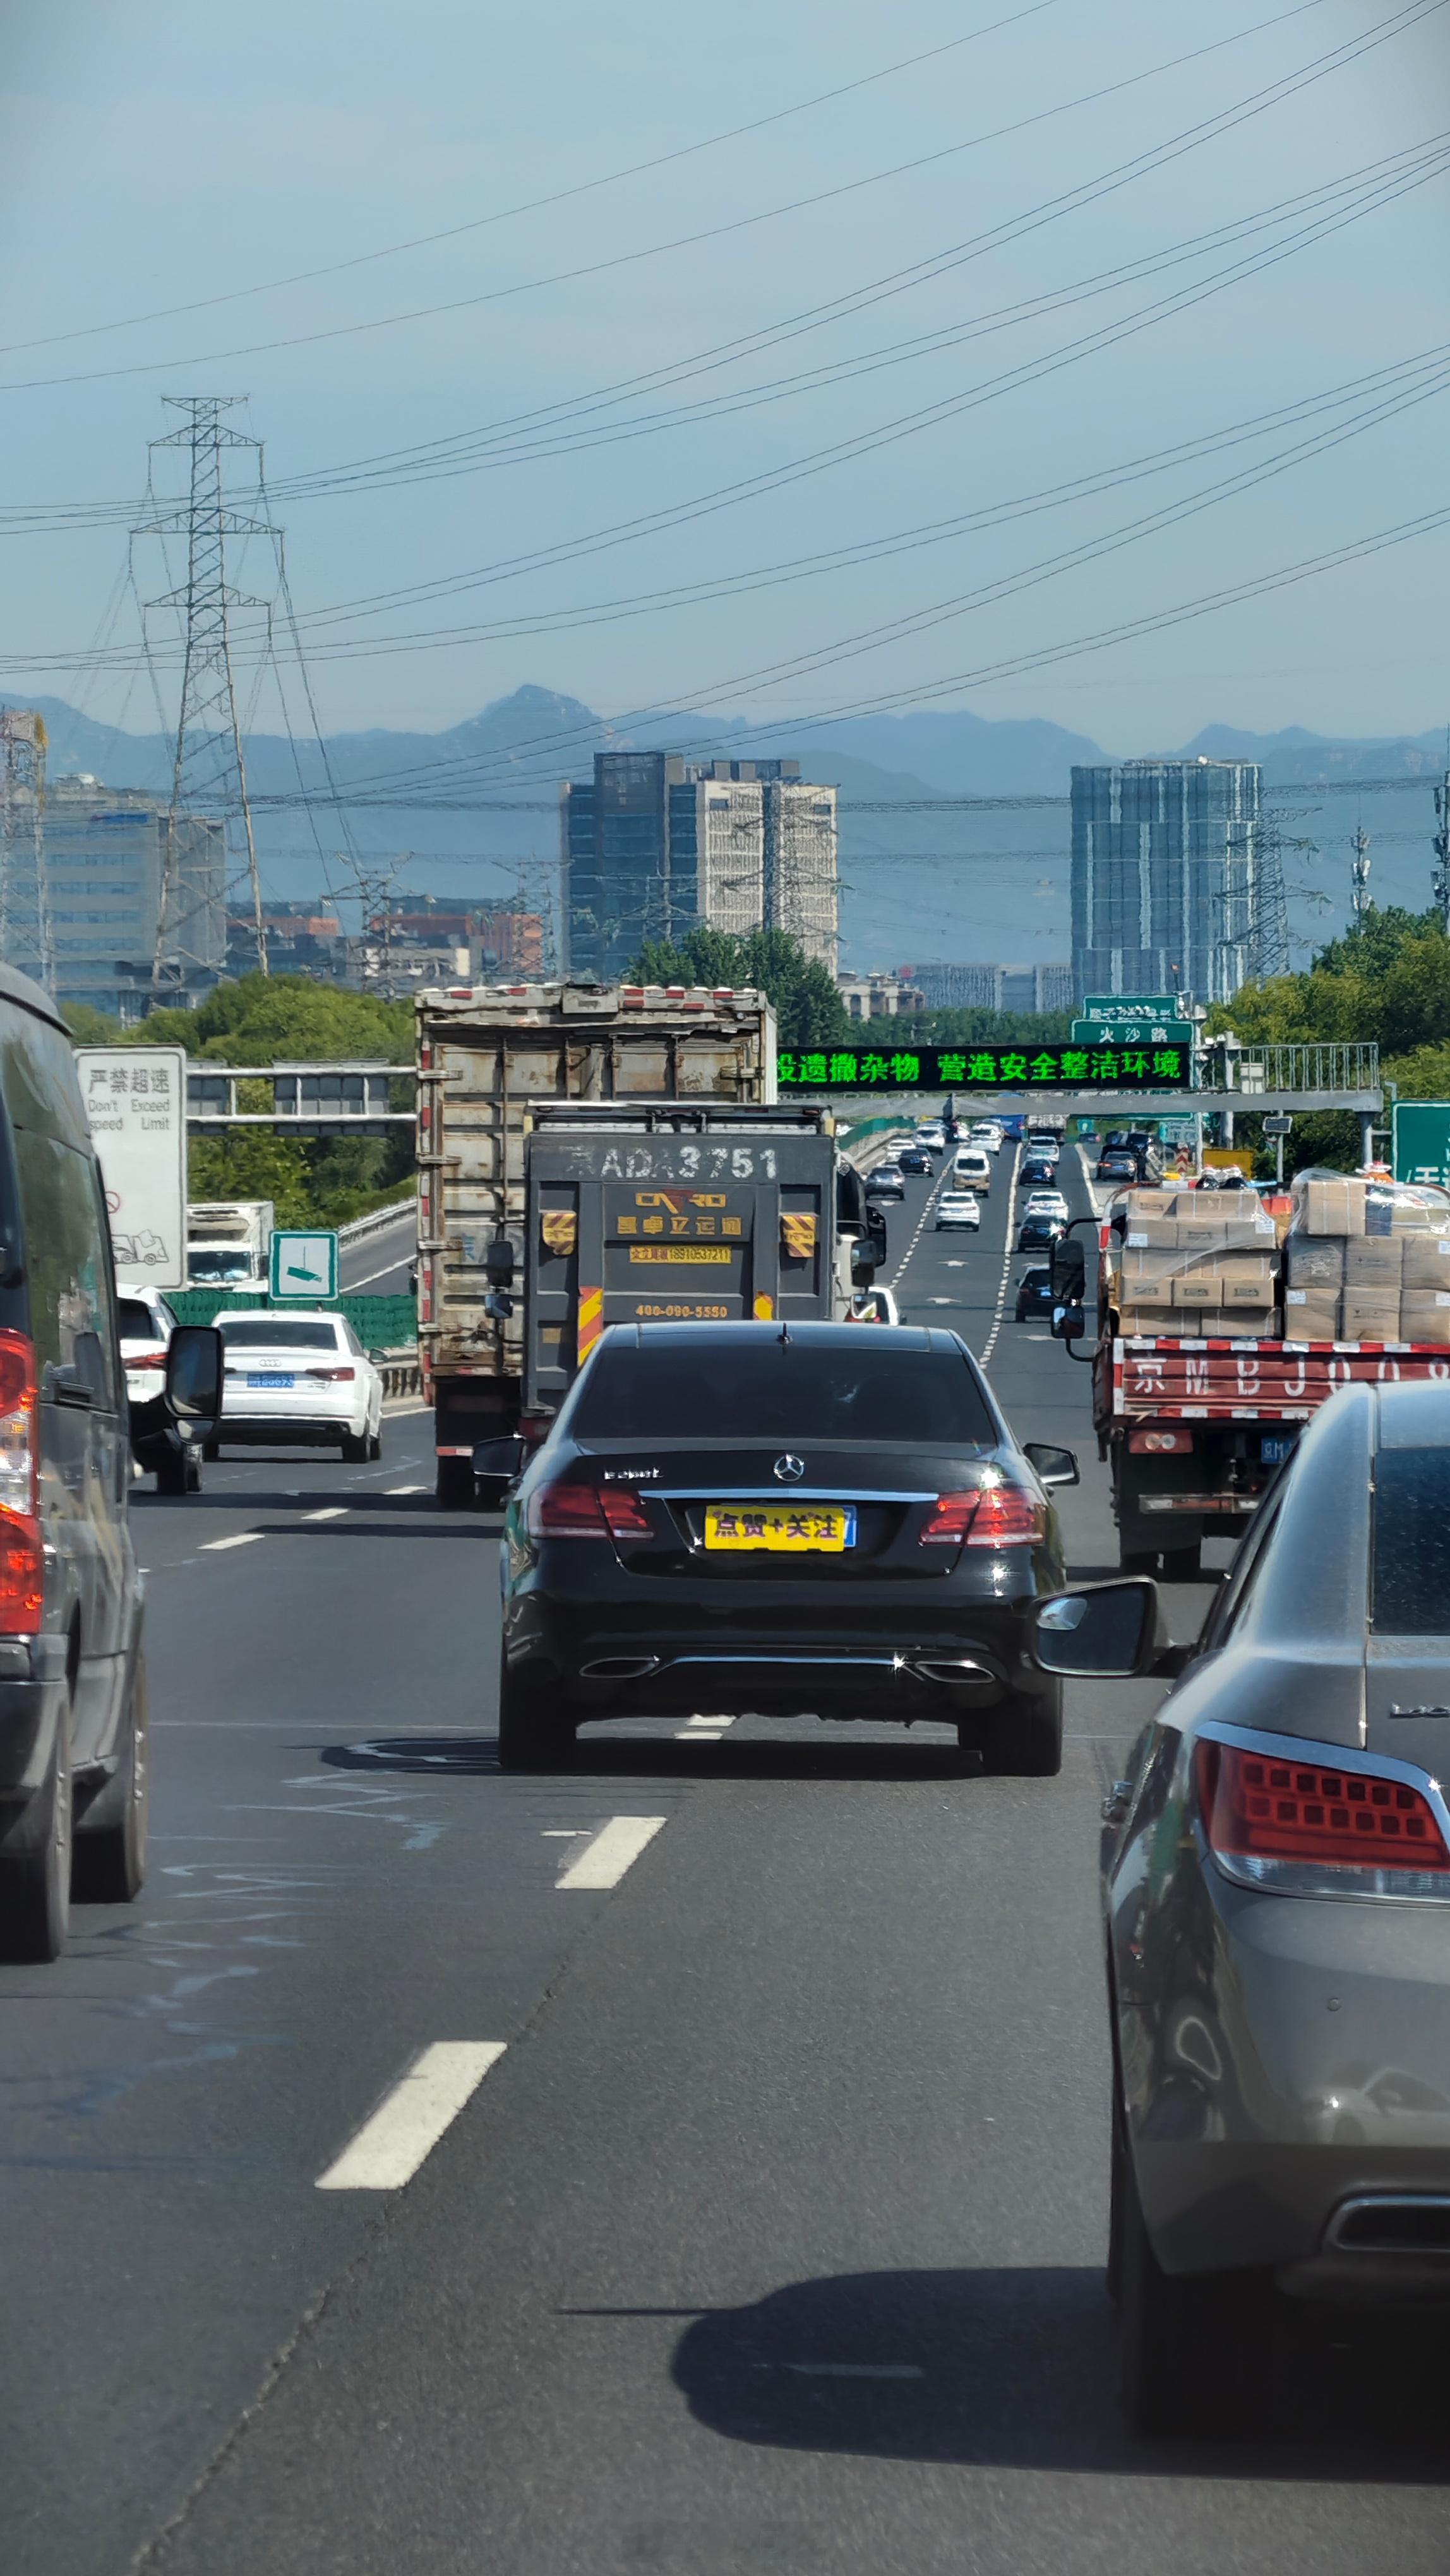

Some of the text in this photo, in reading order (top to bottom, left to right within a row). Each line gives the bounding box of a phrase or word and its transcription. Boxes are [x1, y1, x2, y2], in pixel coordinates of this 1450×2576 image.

[938, 1050, 1182, 1082] 营造安全整洁环境
[88, 1068, 170, 1094] 严禁超速
[131, 1098, 170, 1112] Exceed
